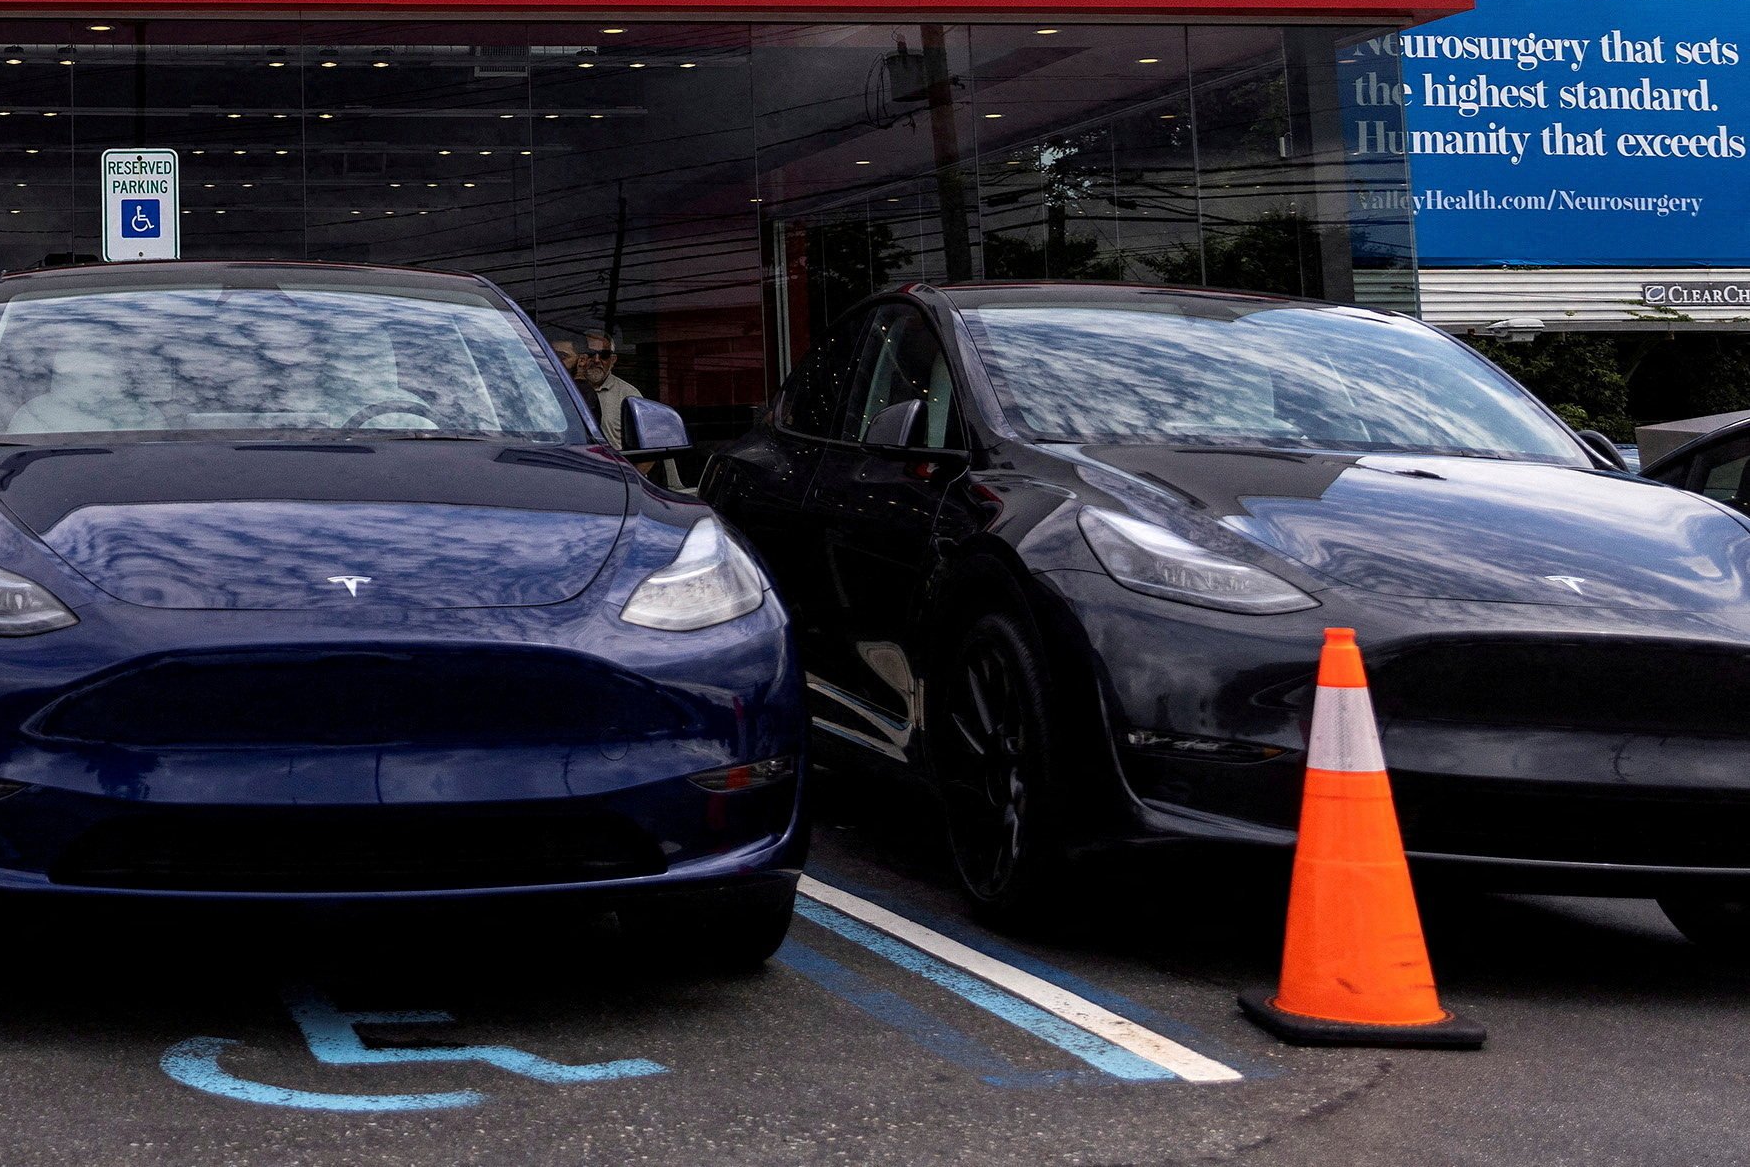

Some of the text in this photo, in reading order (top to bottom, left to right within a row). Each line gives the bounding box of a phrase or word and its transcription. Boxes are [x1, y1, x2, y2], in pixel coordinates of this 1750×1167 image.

[1599, 30, 1666, 64] that
[1675, 36, 1739, 66] sets
[1352, 71, 1719, 118] the highest standard.
[1354, 120, 1746, 166] Humanity that exceeds
[108, 161, 172, 175] RESERVED
[112, 180, 168, 194] PARKING
